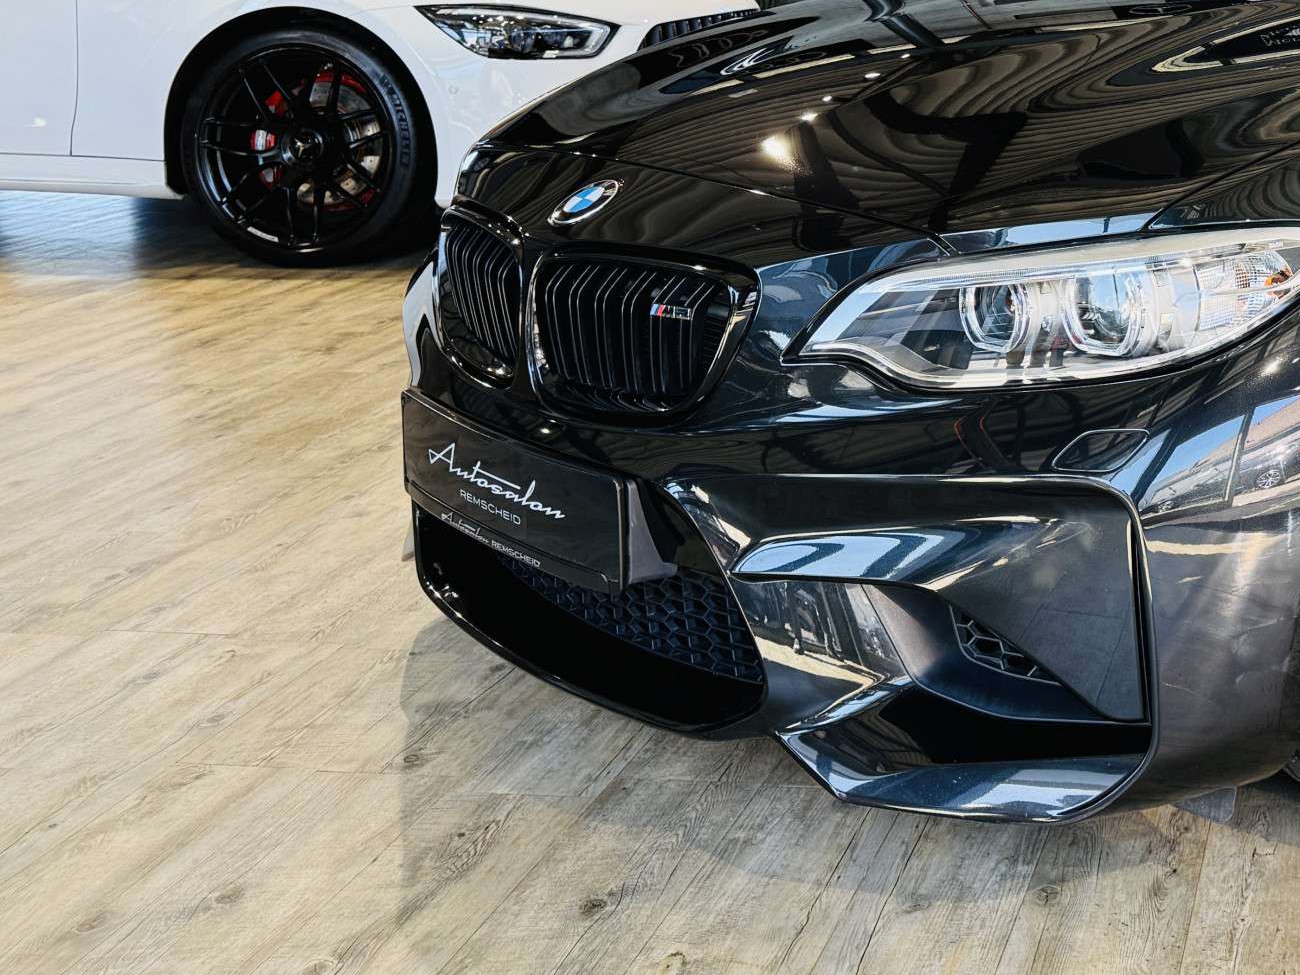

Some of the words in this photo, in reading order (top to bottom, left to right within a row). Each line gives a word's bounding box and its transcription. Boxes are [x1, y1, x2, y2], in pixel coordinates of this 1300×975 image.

[428, 442, 566, 520] Autosalon
[459, 489, 522, 525] REMSCHEID
[491, 539, 541, 568] REMSCHEID
